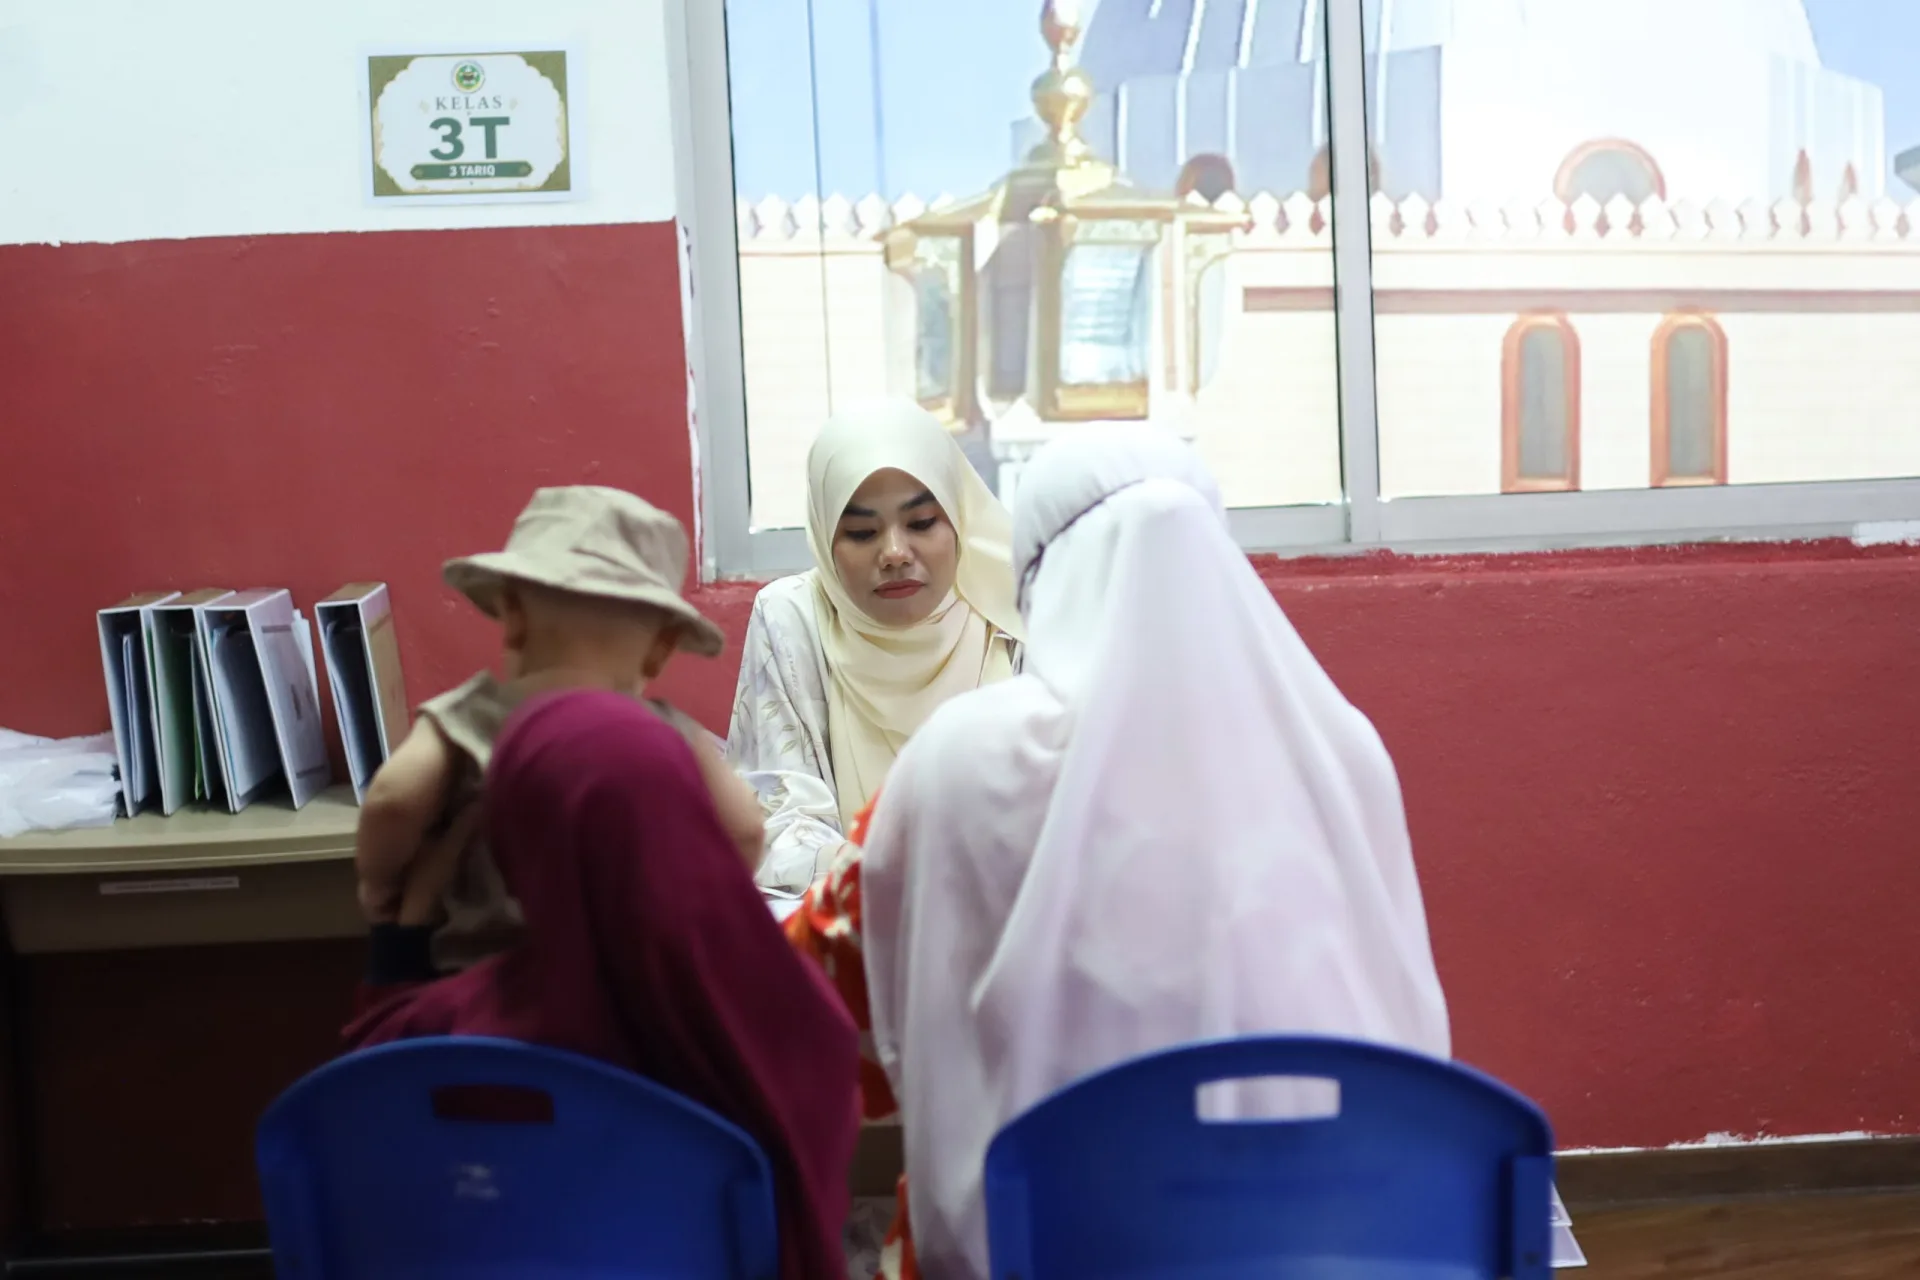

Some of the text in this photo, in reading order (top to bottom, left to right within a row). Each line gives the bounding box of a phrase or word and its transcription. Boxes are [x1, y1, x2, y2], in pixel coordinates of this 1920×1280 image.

[436, 96, 502, 111] KELAS
[429, 116, 510, 161] 3T
[449, 164, 496, 177] 3 TARIQ
